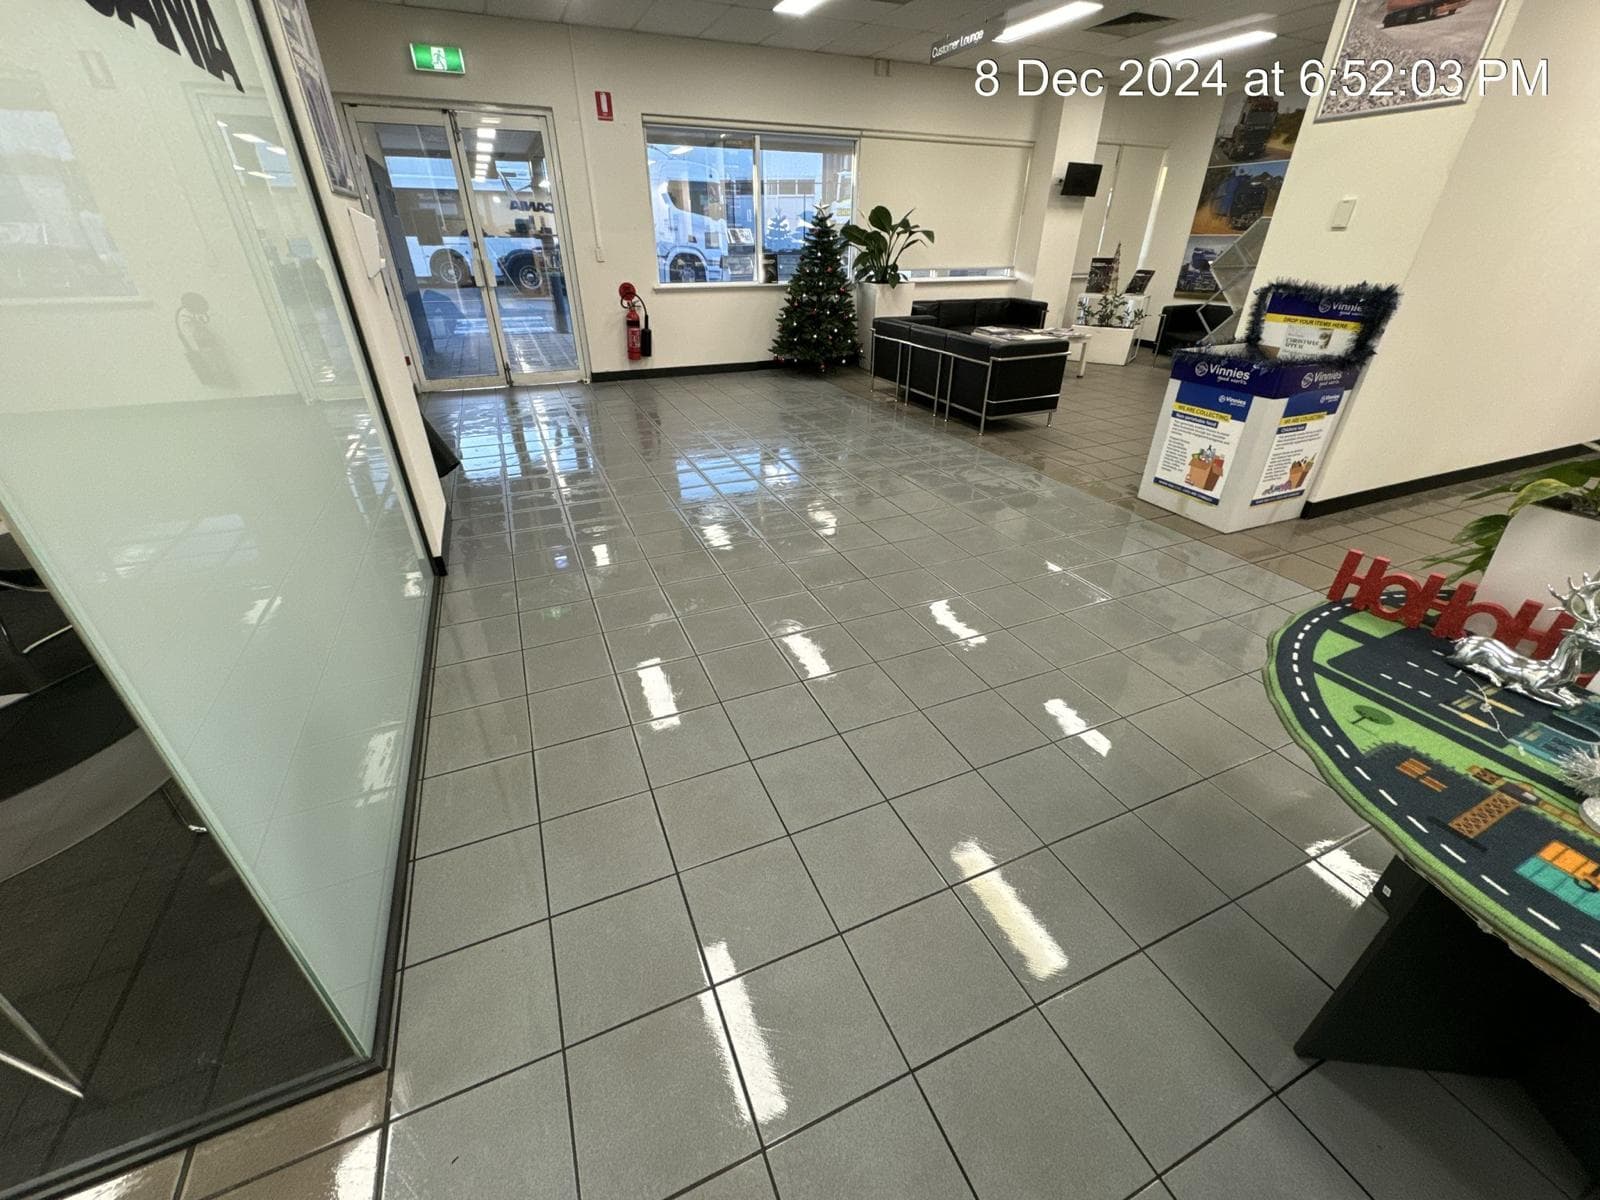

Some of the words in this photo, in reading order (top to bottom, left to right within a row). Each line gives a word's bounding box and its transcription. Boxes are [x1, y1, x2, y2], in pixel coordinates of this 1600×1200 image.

[1332, 301, 1363, 313] Vinnie
[1210, 363, 1250, 381] Vinnies
[1314, 370, 1343, 383] Vinnies
